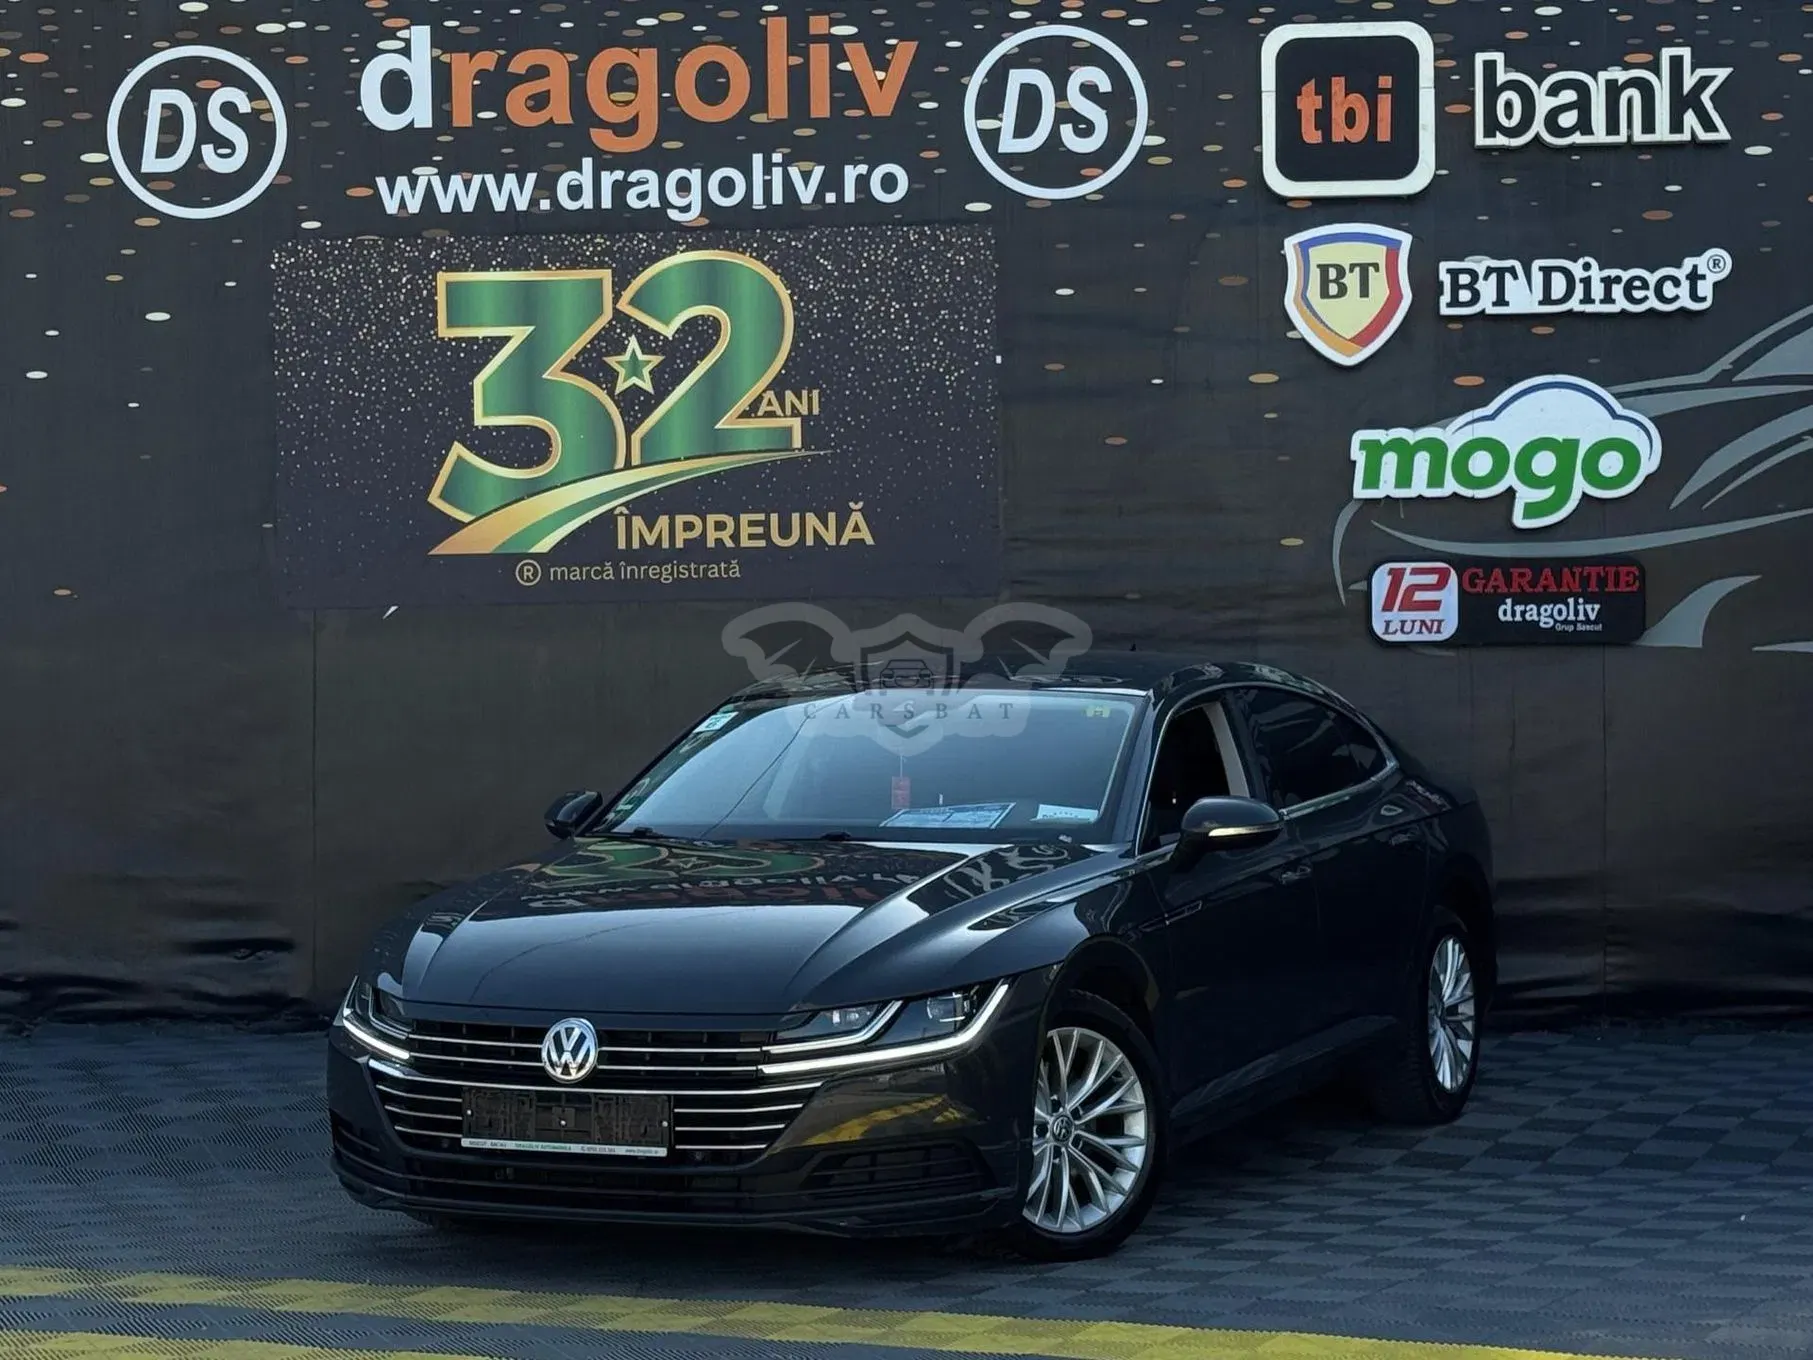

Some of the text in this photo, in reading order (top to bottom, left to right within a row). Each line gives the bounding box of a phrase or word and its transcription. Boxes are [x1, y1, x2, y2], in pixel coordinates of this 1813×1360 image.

[360, 16, 918, 153] dragoliv
[1297, 49, 1729, 146] tbi bank
[141, 86, 251, 174] DS
[998, 66, 1113, 154] DS
[375, 153, 909, 222] www.dragoliv.ro
[1316, 262, 1380, 300] BT
[1444, 265, 1518, 308] BT
[428, 249, 802, 523] 32
[757, 388, 820, 417] ANI
[1359, 436, 1642, 520] mogo
[613, 501, 875, 550] ÎMPREUNĂ
[549, 562, 615, 582] marcă
[619, 560, 741, 584] înregistrată
[1382, 567, 1452, 612] 12
[1461, 565, 1640, 595] GARANTIE
[1382, 618, 1446, 636] LUNI
[1497, 597, 1601, 628] dragoliv
